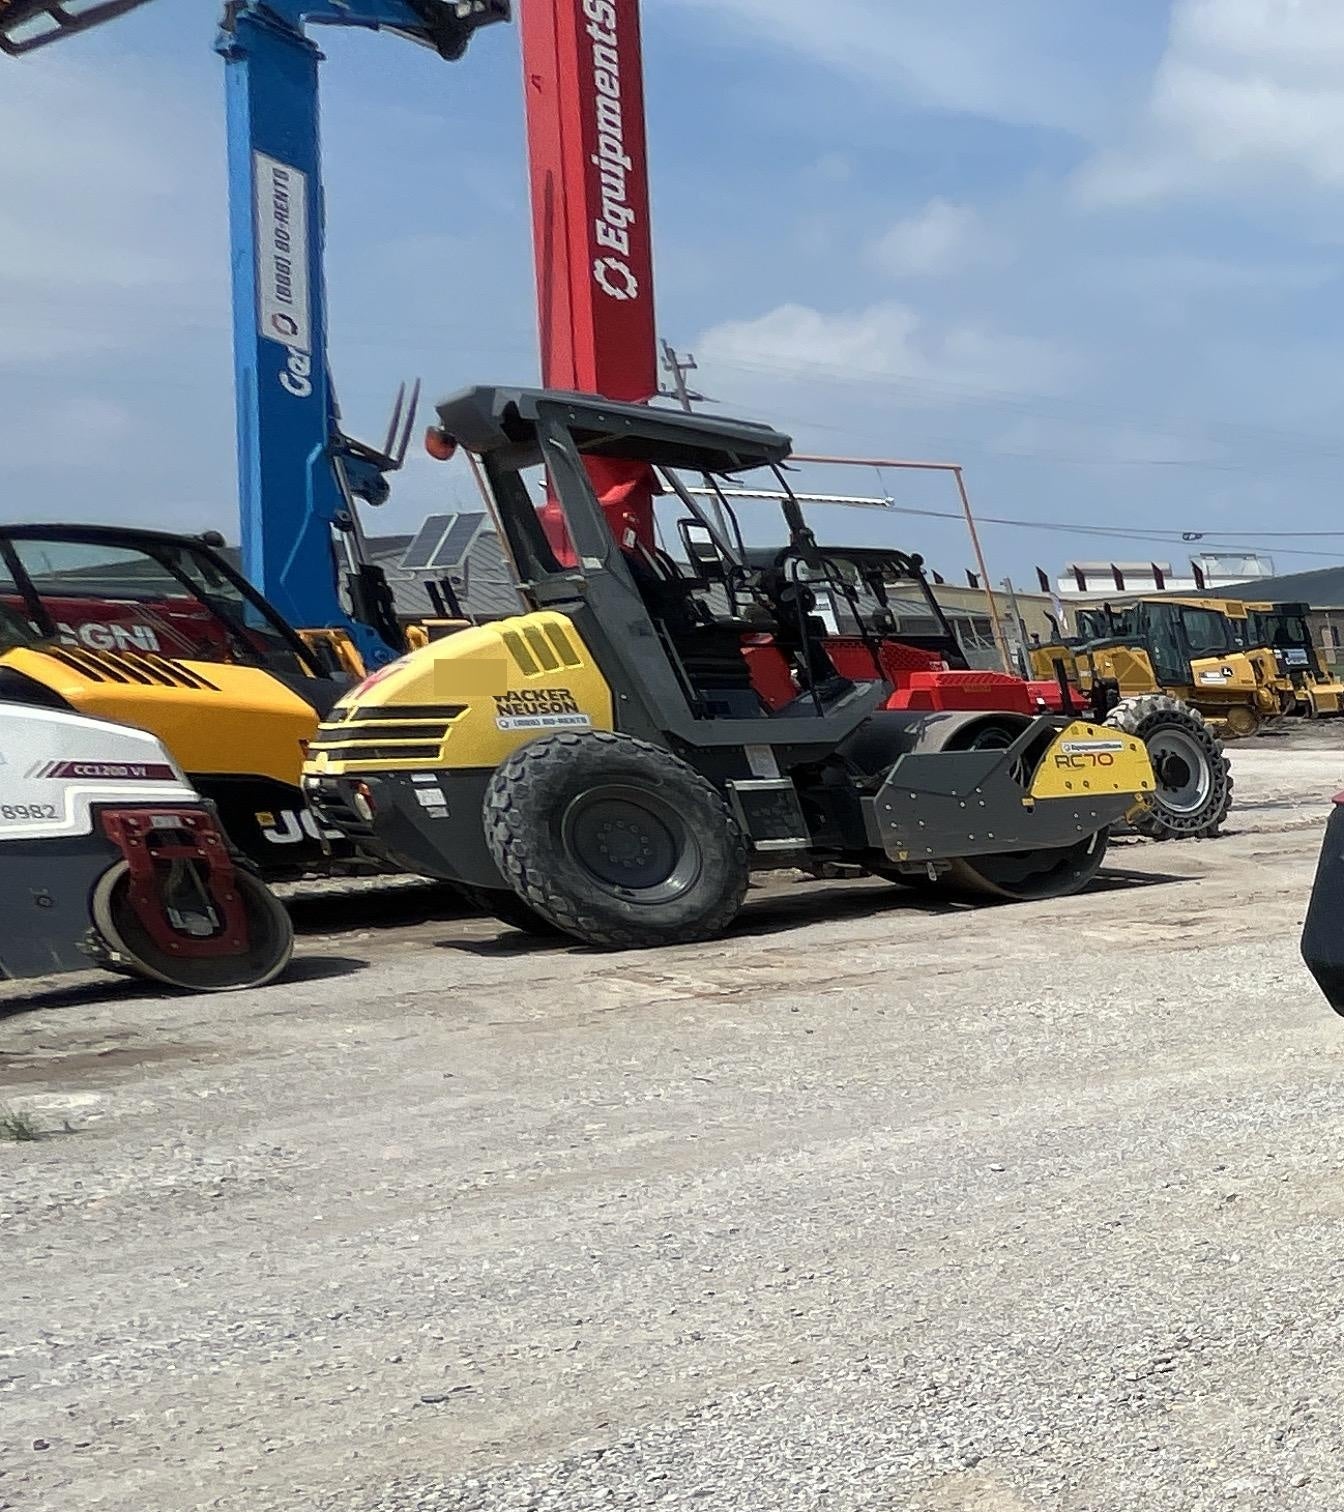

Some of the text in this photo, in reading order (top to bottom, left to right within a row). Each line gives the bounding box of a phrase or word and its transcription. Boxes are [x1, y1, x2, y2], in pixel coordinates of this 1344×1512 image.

[582, 0, 636, 257] EquipmentS
[496, 701, 580, 717] NEUSON
[1054, 753, 1114, 768] RC70
[129, 766, 146, 776] VI
